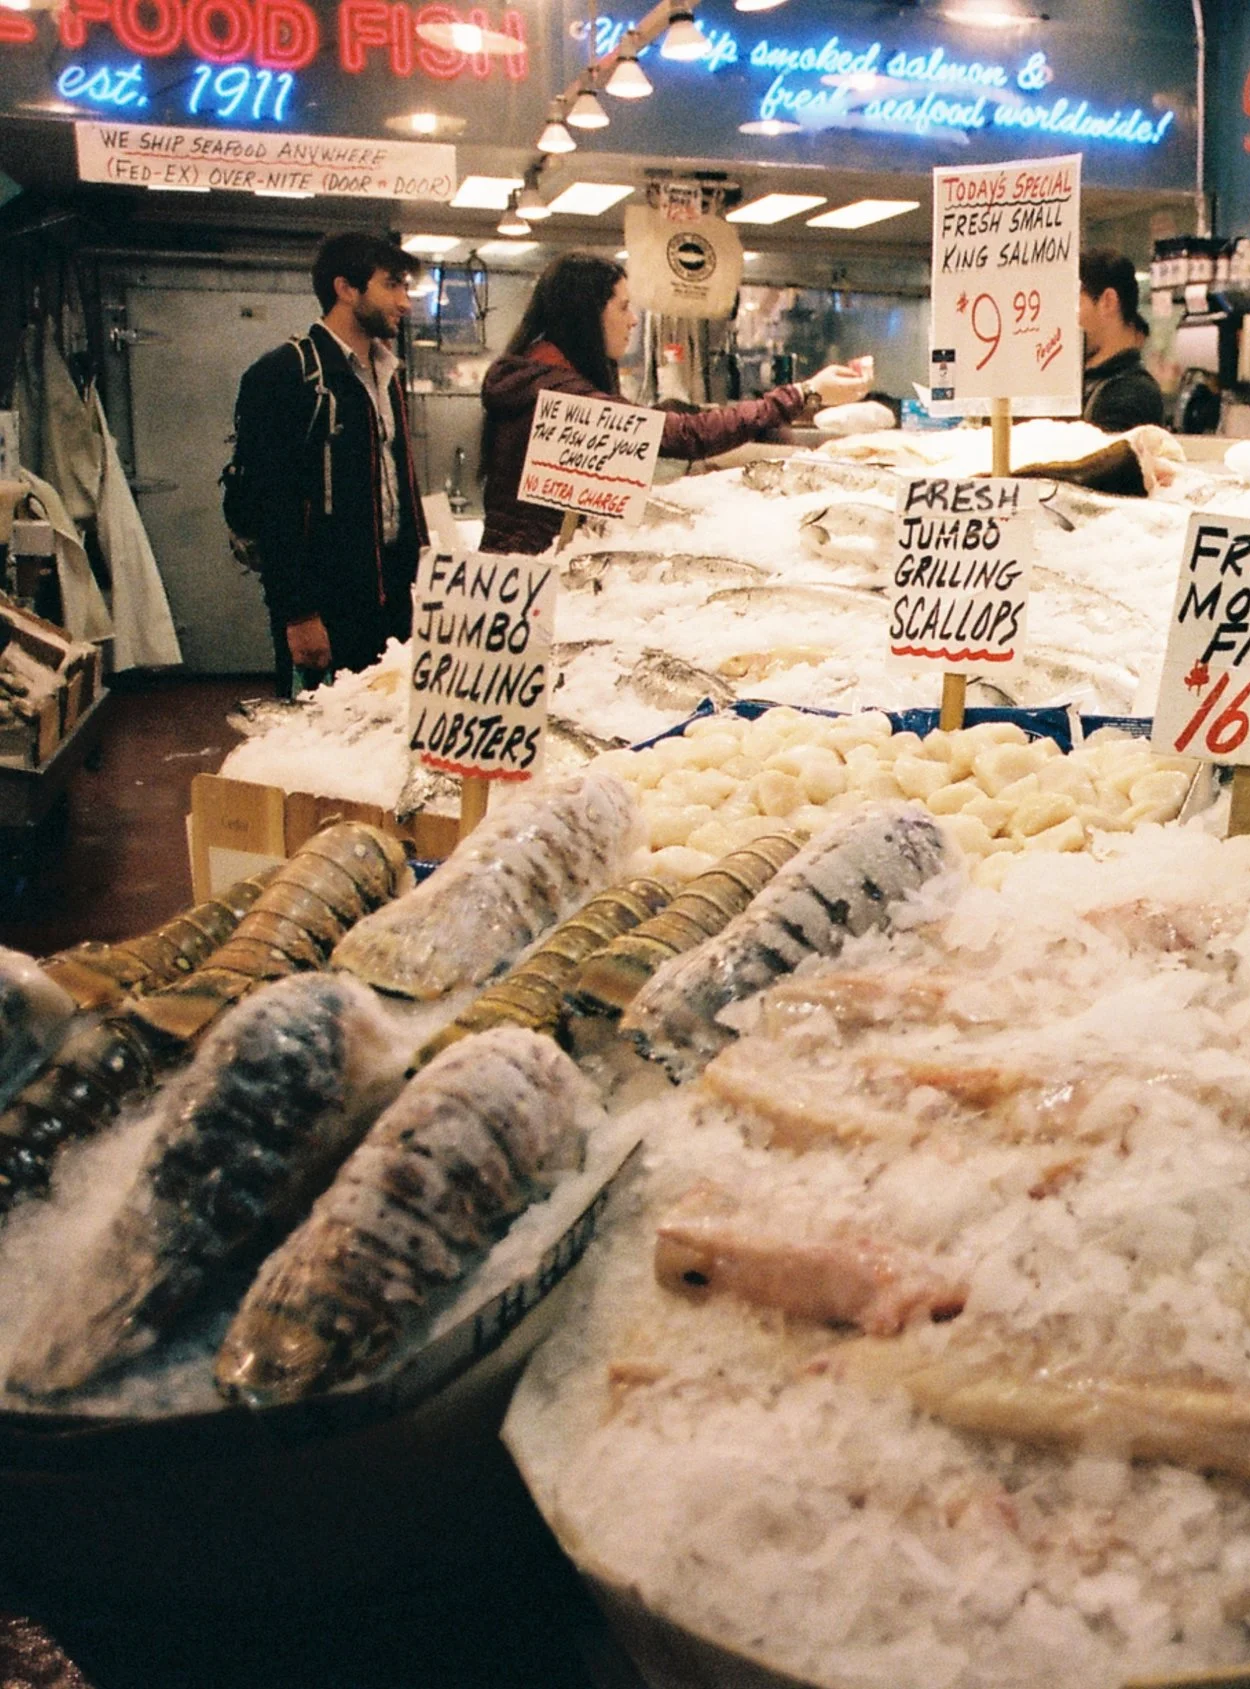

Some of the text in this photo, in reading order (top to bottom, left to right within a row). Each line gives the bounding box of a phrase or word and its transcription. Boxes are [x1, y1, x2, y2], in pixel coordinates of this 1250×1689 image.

[338, 0, 527, 80] FISH
[750, 37, 880, 74] smoked
[887, 47, 1007, 86] salmon
[187, 63, 293, 121] 1911
[864, 91, 985, 132] seafood
[994, 98, 1173, 144] worldwide!
[100, 129, 389, 165] WE SHIP SEAFOOD ANYWHERE
[1013, 169, 1071, 199] SPECIAL
[942, 204, 1062, 238] FRESH SMALL
[942, 231, 1071, 273] KING SALMON
[539, 399, 647, 434] WE WILL FILLET
[533, 423, 650, 461] THE FISH OF YOUR
[559, 449, 608, 472] CHOICE
[524, 475, 630, 513] NO EXTRA CHARGE
[905, 479, 1020, 514] FRESH
[899, 517, 1001, 551] JUMBO
[429, 554, 551, 617] FANCY
[894, 554, 1023, 591] GRILLING
[417, 601, 530, 654] JUMBO
[890, 595, 1025, 646] SCALLOPS
[412, 650, 545, 708] GRILLING
[410, 707, 541, 769] LOBSTERS
